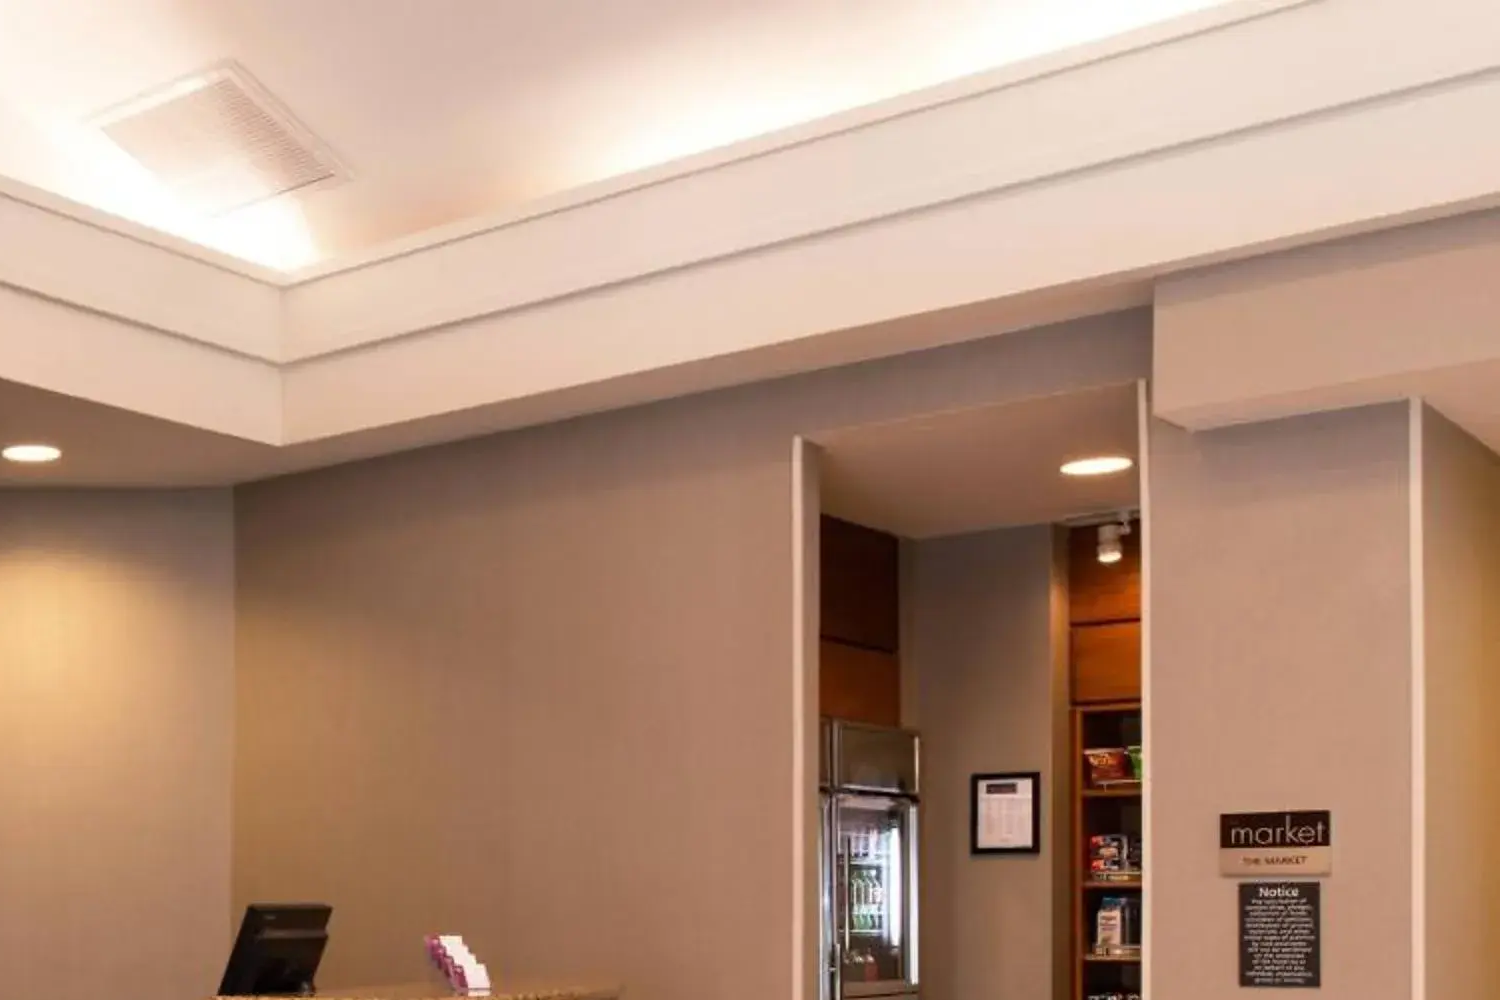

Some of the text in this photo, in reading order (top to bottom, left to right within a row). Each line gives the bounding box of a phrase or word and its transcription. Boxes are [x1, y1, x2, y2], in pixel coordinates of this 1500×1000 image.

[1231, 814, 1323, 845] market
[1265, 855, 1308, 865] MARKET
[1259, 886, 1299, 897] Notice
